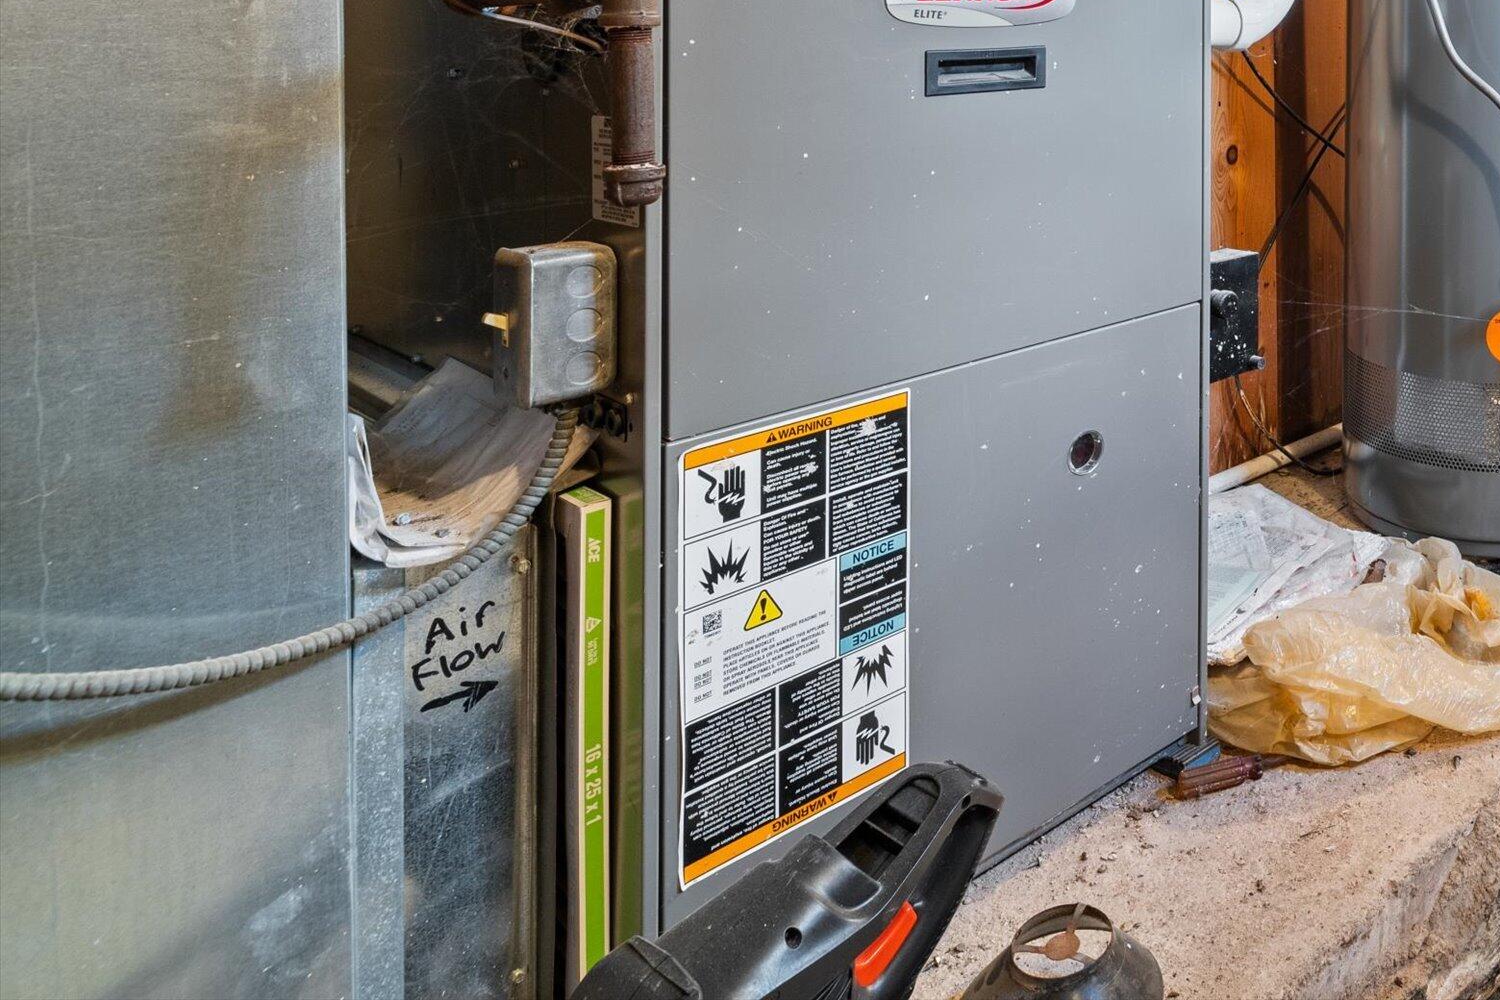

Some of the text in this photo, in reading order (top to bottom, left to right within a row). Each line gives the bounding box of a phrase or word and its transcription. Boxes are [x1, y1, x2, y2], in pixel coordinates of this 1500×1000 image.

[914, 9, 944, 20] ELITE
[778, 417, 833, 441] WARNING
[588, 536, 602, 563] ACE
[852, 540, 894, 564] NOTICE
[425, 600, 495, 655] Air
[853, 620, 894, 647] NOTICE
[411, 630, 505, 691] Flow
[586, 743, 602, 826] 16 x 25 x 1
[773, 797, 826, 832] WARNING
